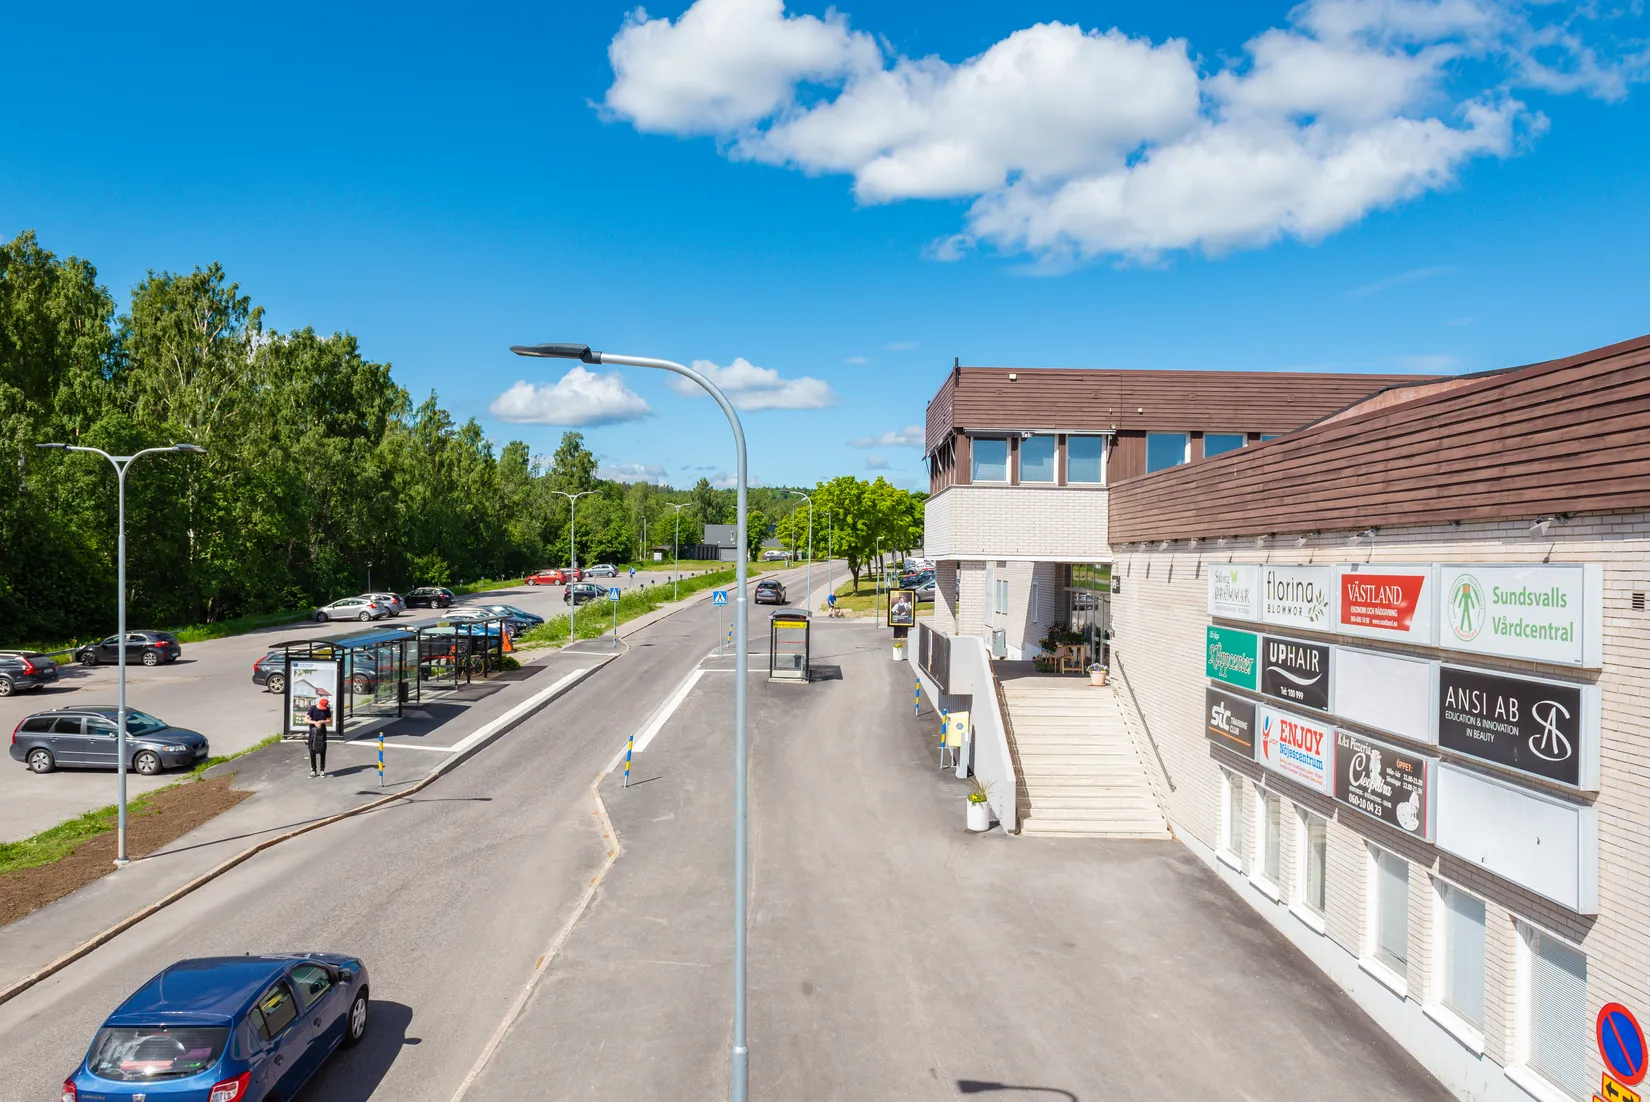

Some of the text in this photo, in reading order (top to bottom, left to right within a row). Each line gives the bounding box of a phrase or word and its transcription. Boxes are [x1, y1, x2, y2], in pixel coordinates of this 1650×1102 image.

[1267, 570, 1314, 603] florina
[1347, 580, 1403, 605] VÄSTLAND
[1492, 586, 1567, 608] Sundsvalls
[1267, 603, 1303, 617] BLOMMOR
[1492, 615, 1574, 642] Vårdcentral
[1269, 642, 1320, 673] UPHAIR
[1445, 686, 1520, 722] ANSI AB
[1230, 725, 1239, 735] CLUB
[1231, 717, 1247, 730] TRAINING
[1445, 710, 1519, 736] EDUCATION & INNOVATION
[1466, 727, 1495, 743] IN BEAUTY
[1280, 719, 1324, 756] ENJOY
[1349, 737, 1373, 756] Pizzeria
[1279, 742, 1324, 771] Nöjescentrum
[1348, 792, 1366, 809] 060-10
[1366, 800, 1374, 813] 04
[1374, 804, 1382, 816] 23
